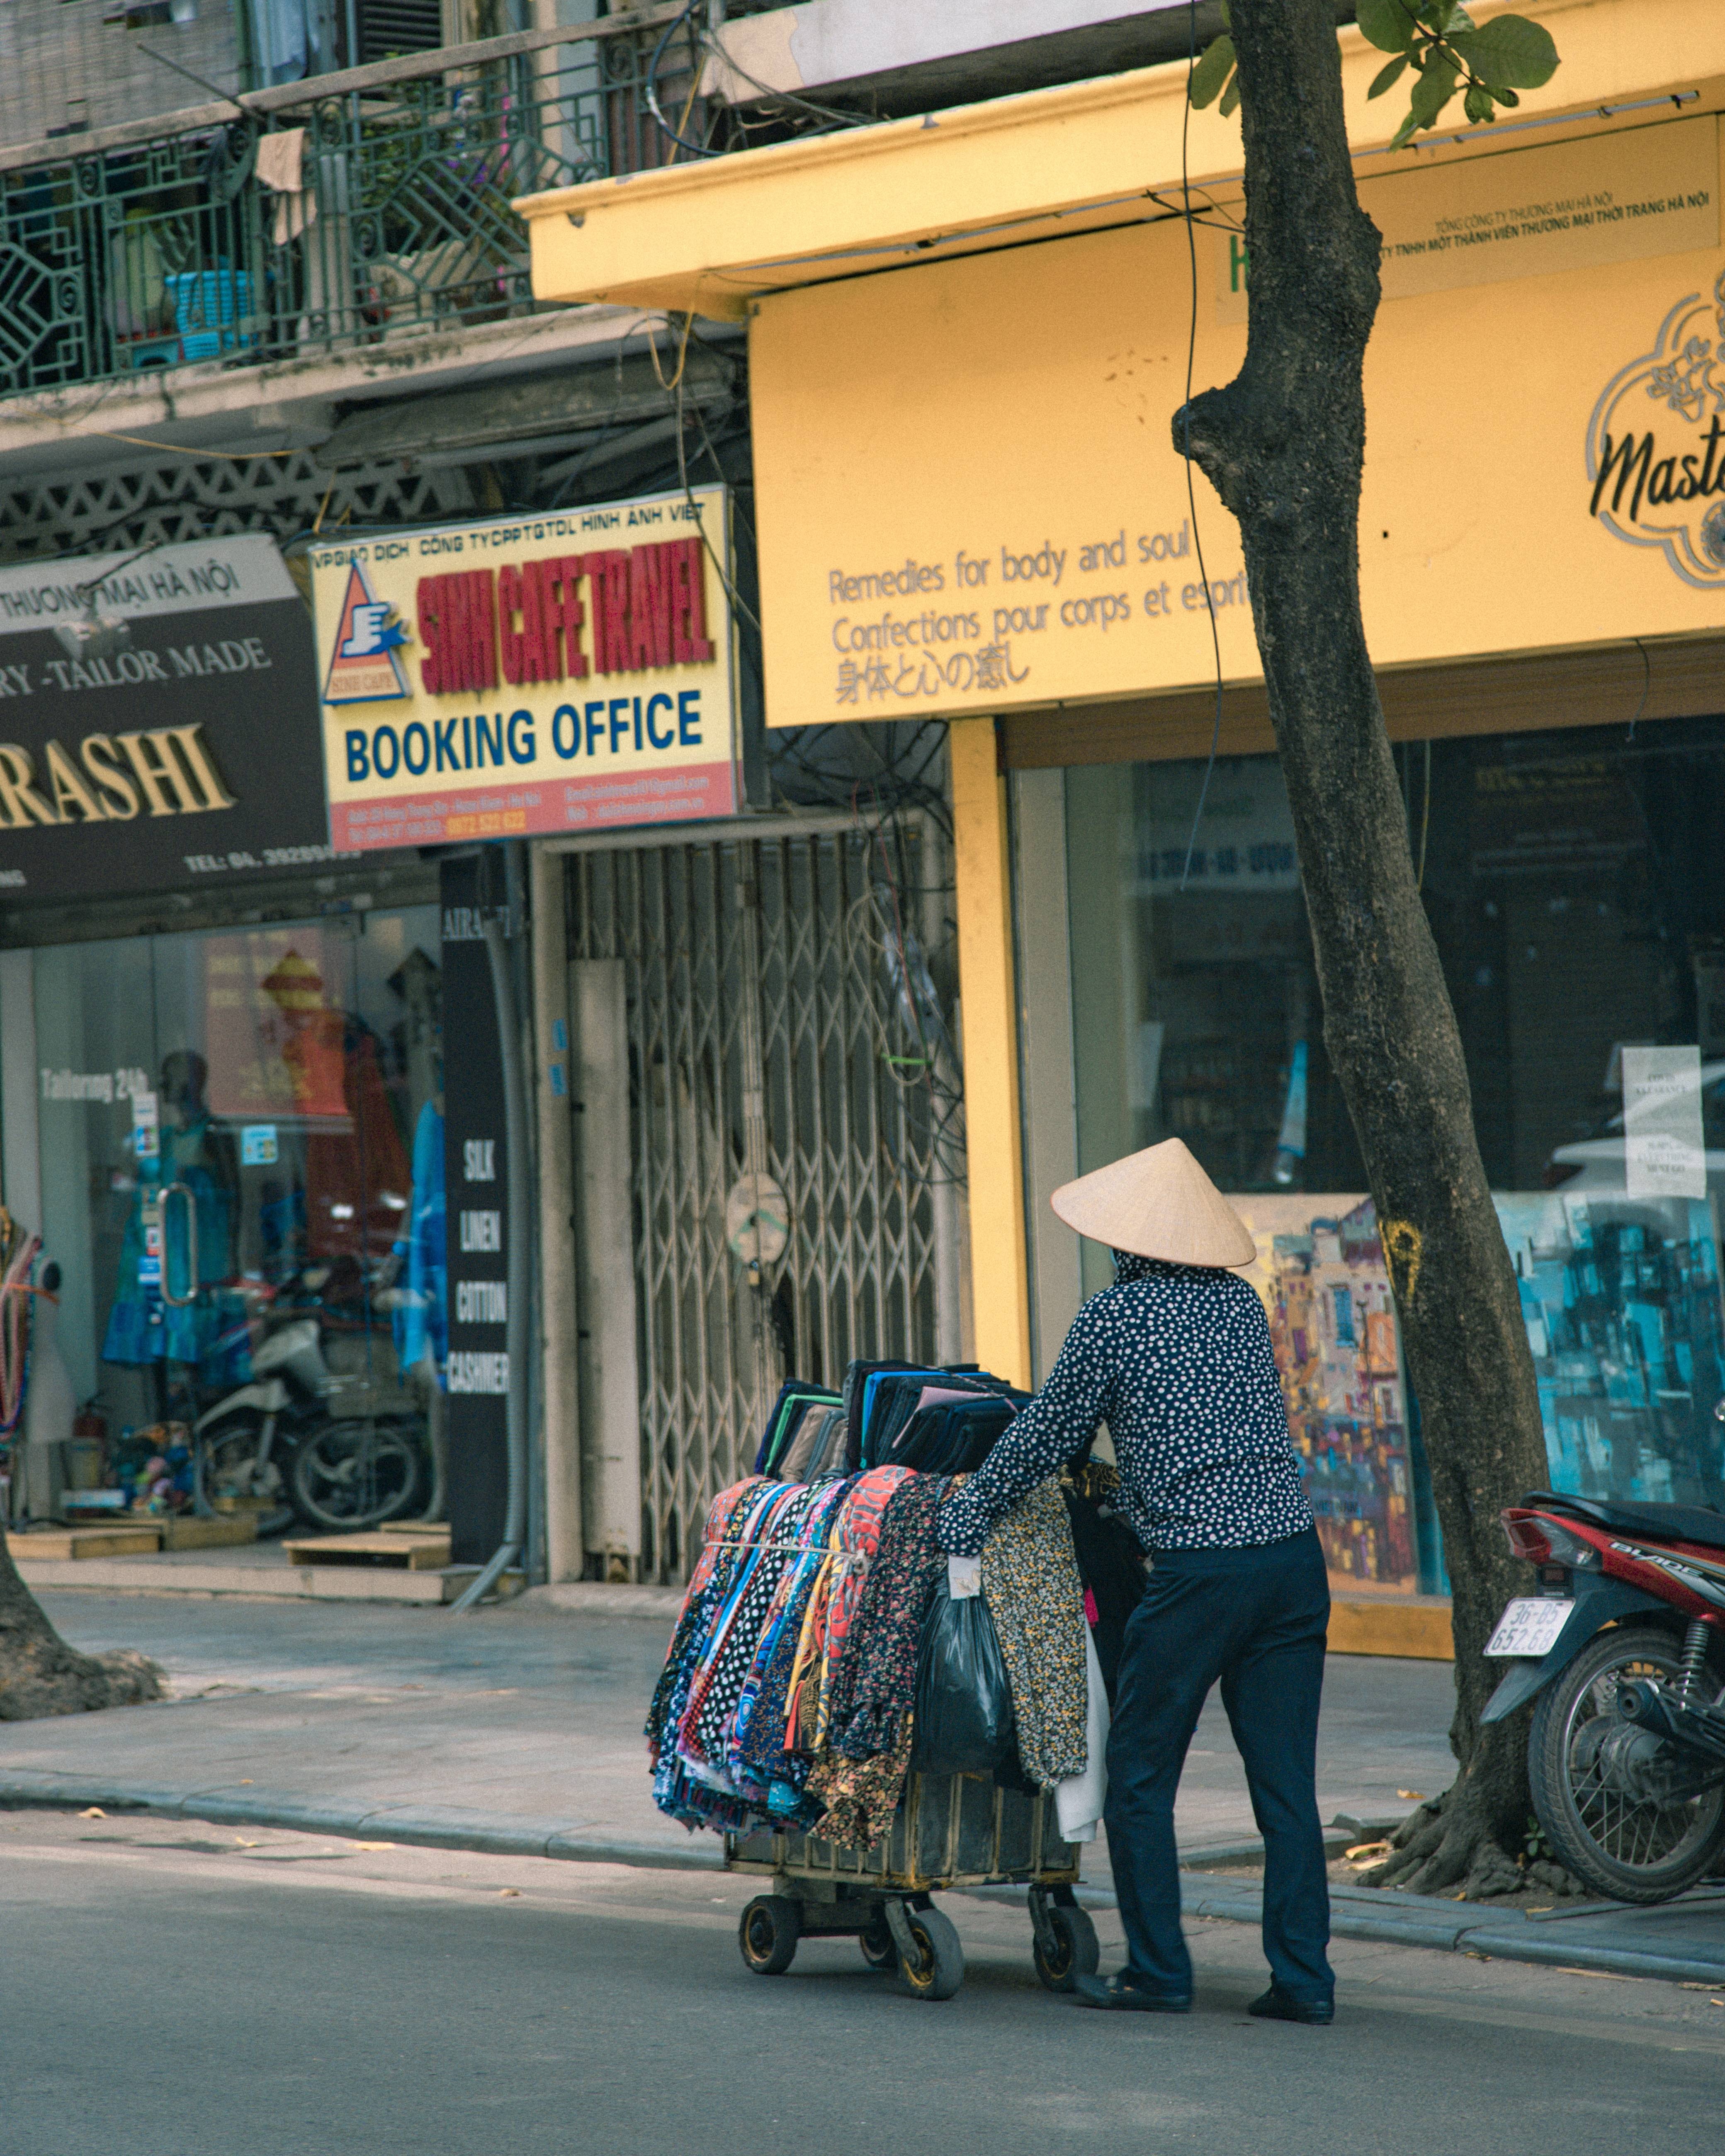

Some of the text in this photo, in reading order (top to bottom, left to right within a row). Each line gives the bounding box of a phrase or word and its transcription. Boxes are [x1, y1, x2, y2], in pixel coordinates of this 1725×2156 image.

[1396, 240, 1426, 256] TNHH
[1626, 202, 1666, 219] TRANG
[1668, 195, 1685, 211] HÀ
[1688, 190, 1710, 210] NỘI
[190, 558, 241, 596] NỘI
[829, 518, 1191, 604] Remedies for body and soul
[416, 536, 716, 695] SINH CAFE TRAVEL
[832, 571, 1250, 654] Confections pour corps et espri
[168, 637, 272, 679] MADE
[835, 641, 1030, 704] 身体と心の癒し
[345, 690, 702, 782] BOOKING OFFICE
[0, 722, 238, 828] RASHI
[463, 1139, 495, 1182] SILK
[460, 1209, 500, 1252] LINEN
[456, 1280, 506, 1323] COTTON
[1609, 1542, 1703, 1578] BLADE
